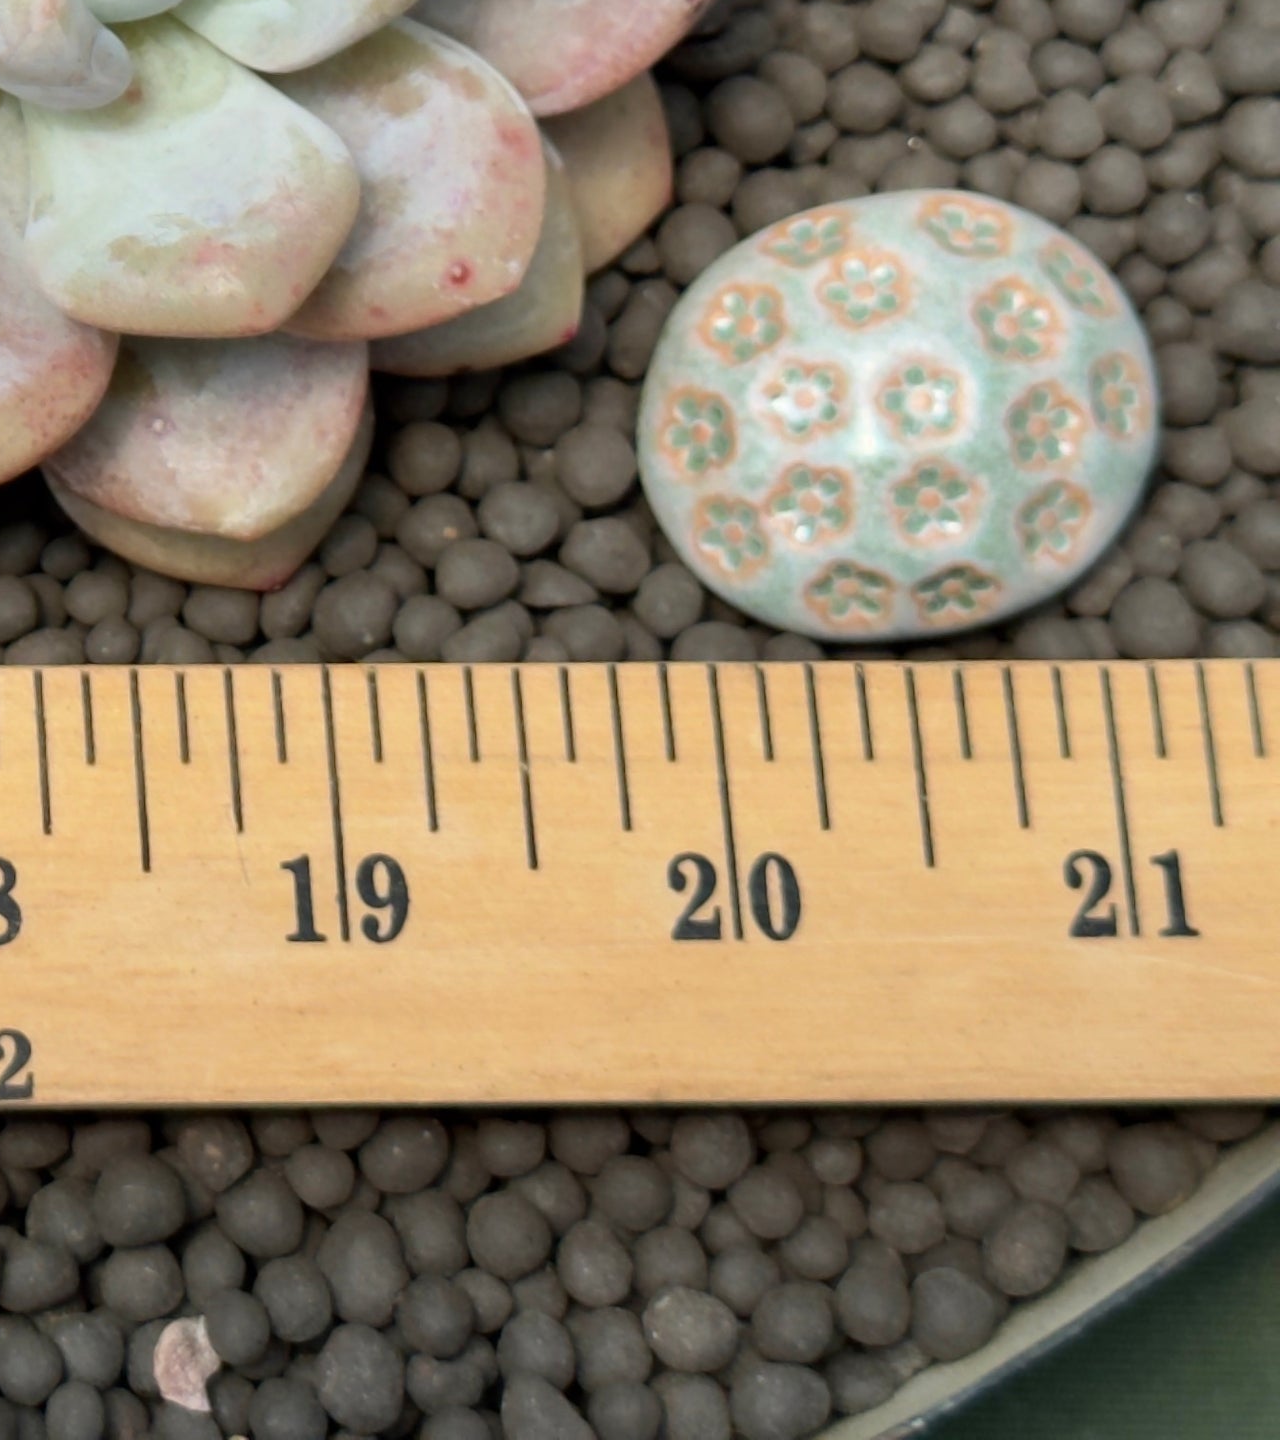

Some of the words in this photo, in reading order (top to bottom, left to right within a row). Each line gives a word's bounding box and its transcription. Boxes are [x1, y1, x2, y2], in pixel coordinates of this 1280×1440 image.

[280, 853, 411, 943] 19
[666, 851, 802, 942] 20
[1063, 850, 1201, 938] 21
